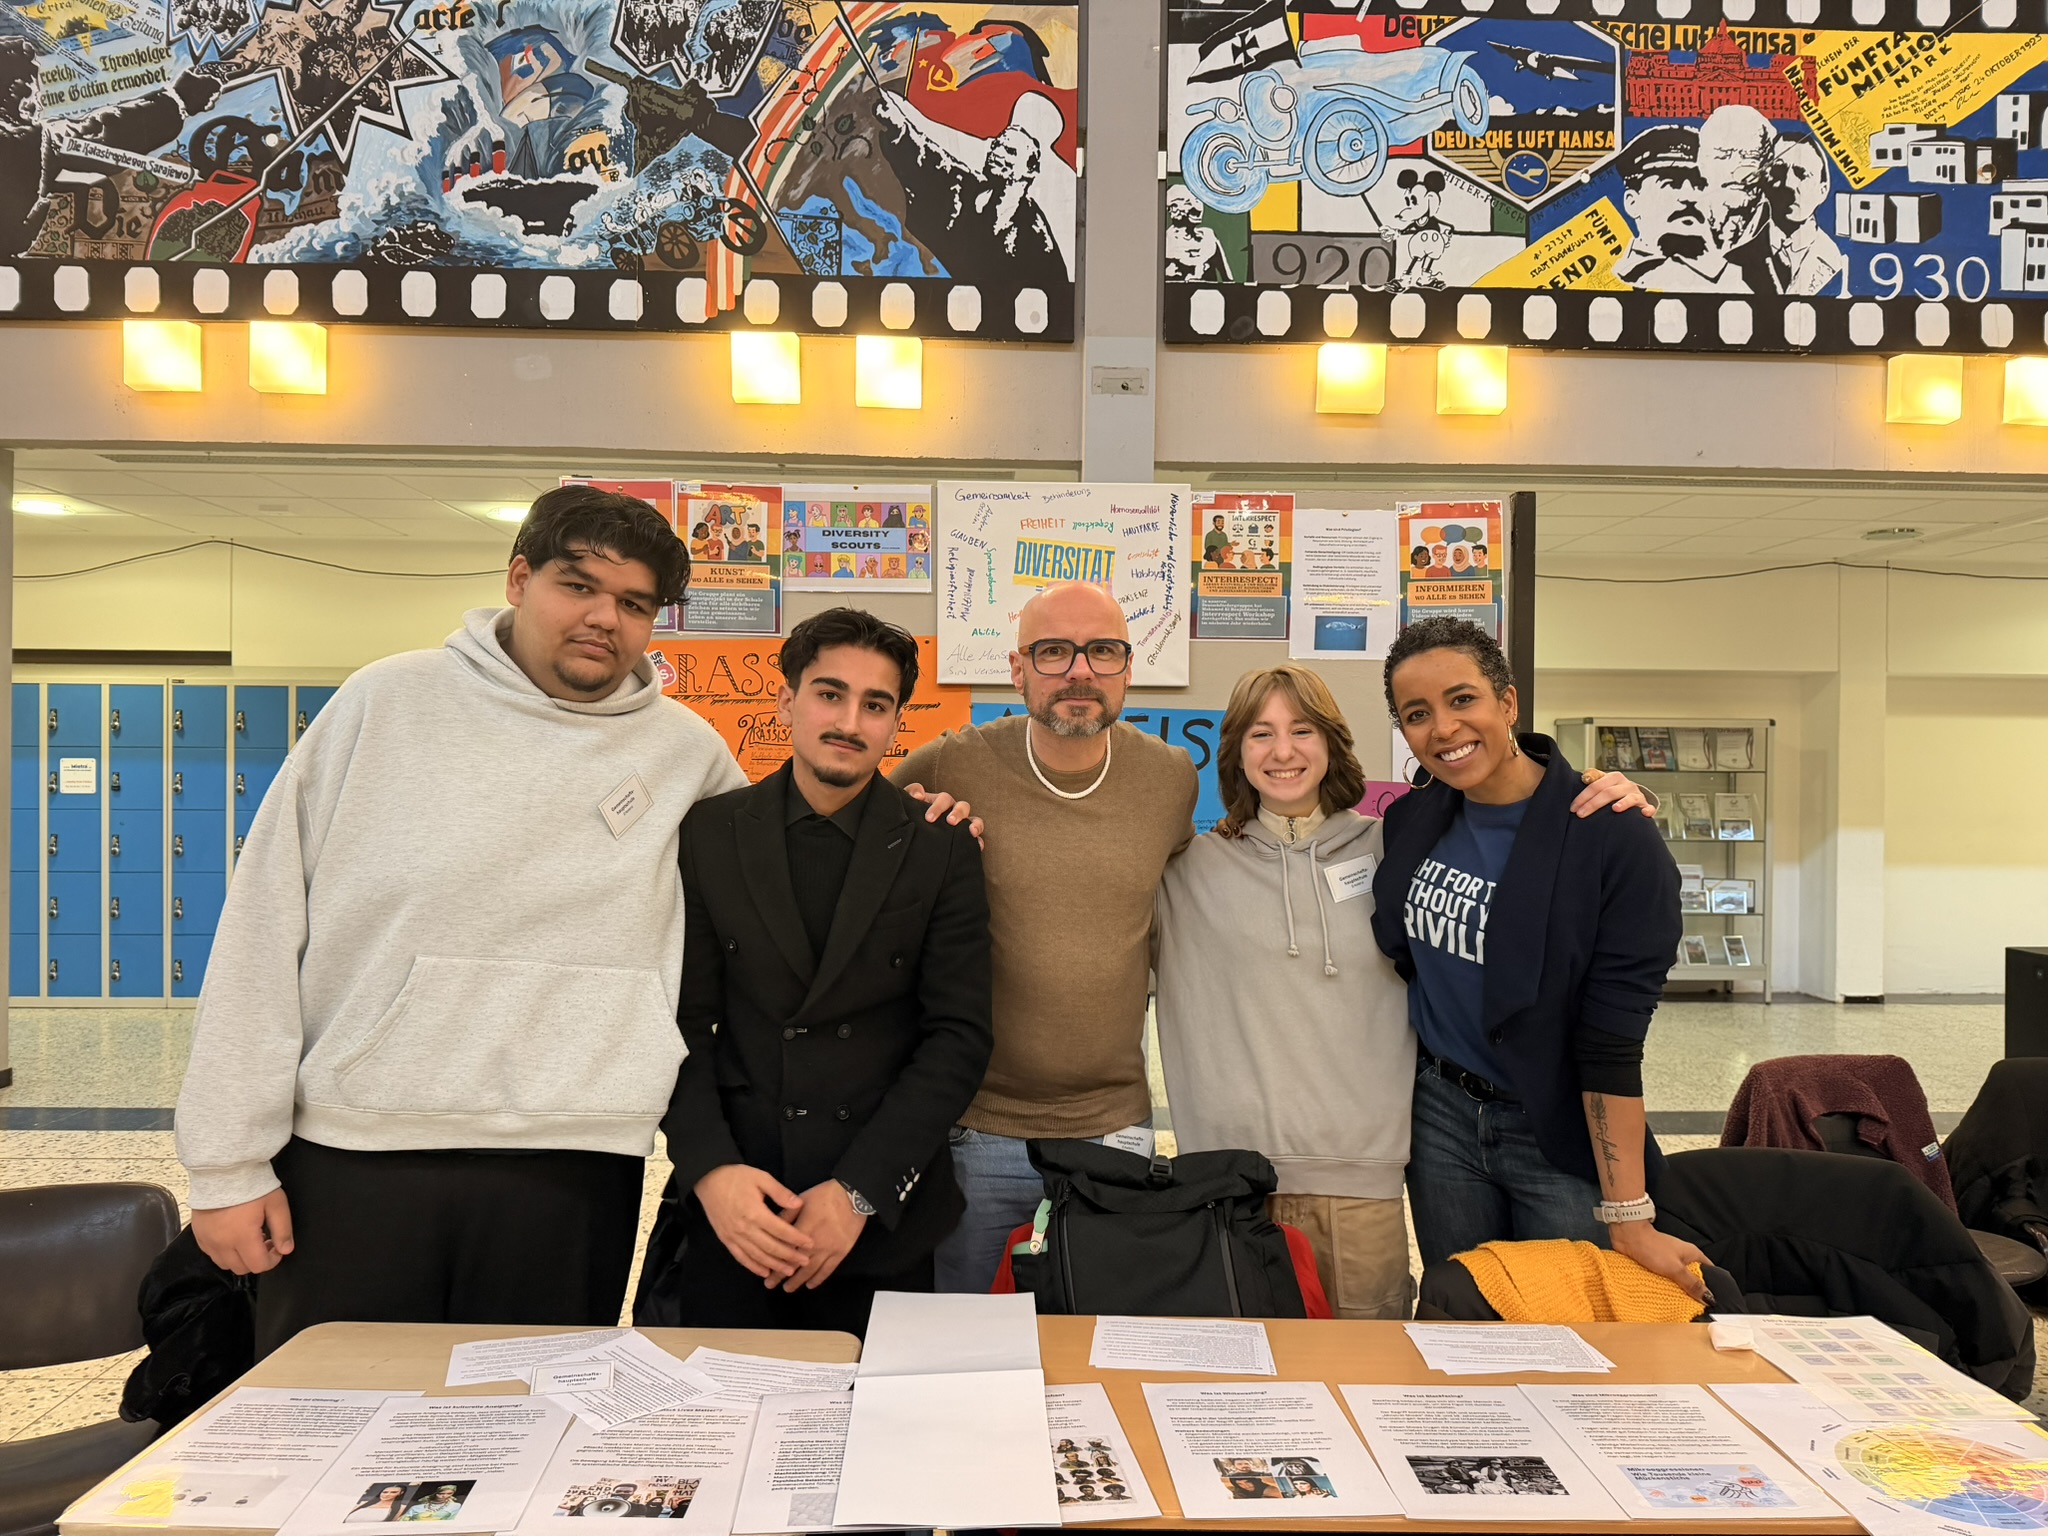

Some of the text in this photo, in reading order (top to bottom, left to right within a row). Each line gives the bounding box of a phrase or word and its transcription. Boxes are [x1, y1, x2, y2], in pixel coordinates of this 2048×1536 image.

[100, 46, 172, 73] Thronfolger
[1895, 43, 1953, 88] MARK
[68, 81, 109, 102] Gattin
[1434, 129, 1616, 149] DEUTSCHE LUFT HANSA
[705, 503, 747, 526] ART
[1020, 517, 1066, 531] FREIHEIT
[1122, 521, 1161, 538] HAUTFARBE
[822, 529, 890, 538] DIVERSITY
[831, 541, 881, 550] SCOUTS
[710, 567, 746, 576] KUNST
[1203, 575, 1279, 584] INTERRESPECT!
[703, 576, 724, 584] ALLE
[736, 577, 764, 585] SEHEN
[1415, 584, 1486, 593] INFORMIEREN
[1442, 867, 1485, 899] FOR
[1406, 877, 1477, 924] THOUT
